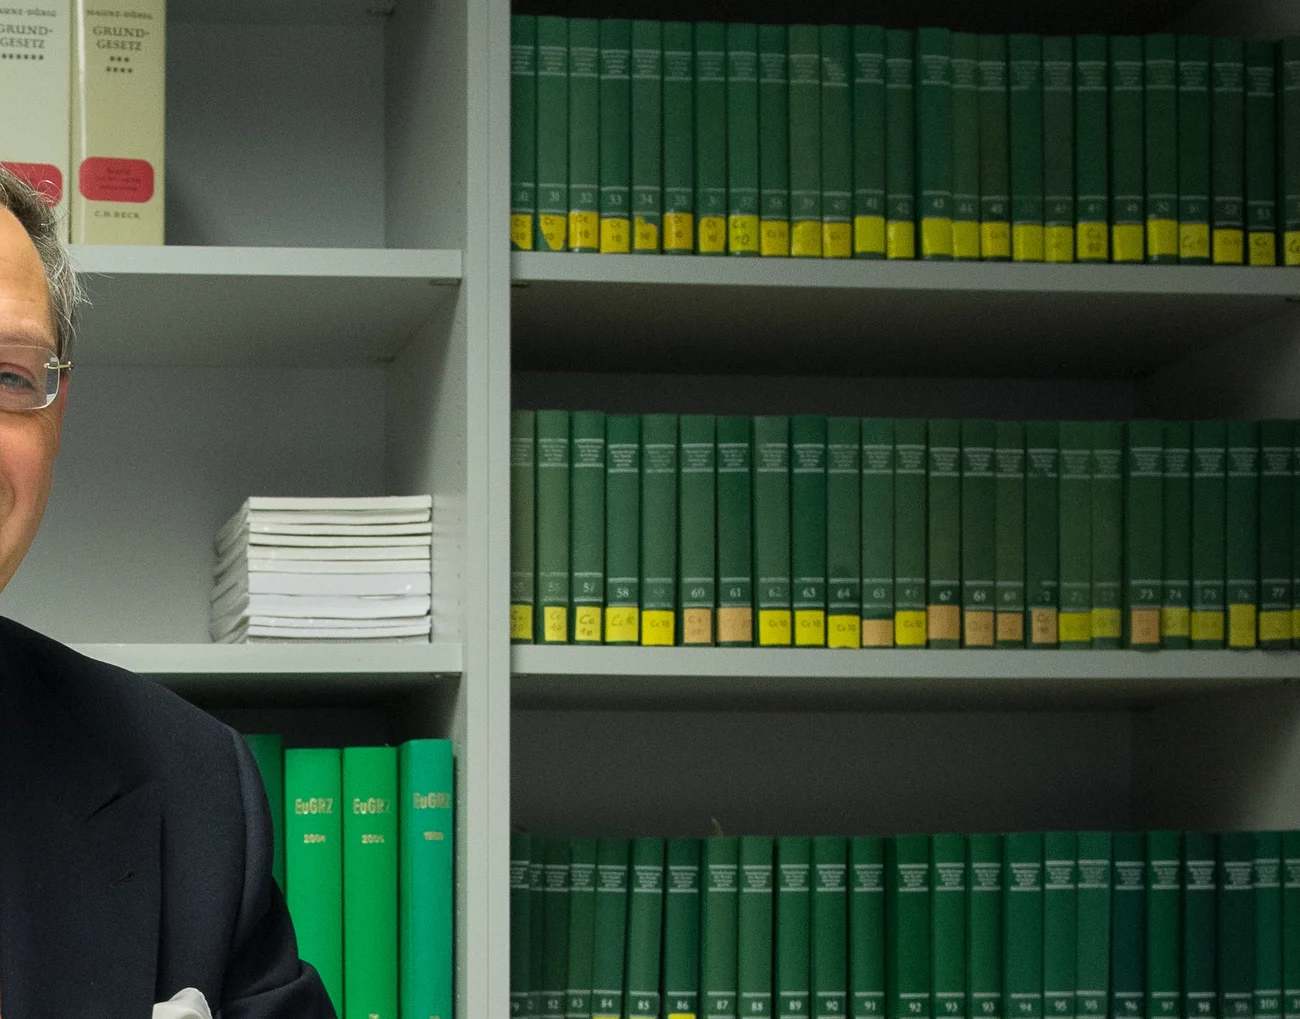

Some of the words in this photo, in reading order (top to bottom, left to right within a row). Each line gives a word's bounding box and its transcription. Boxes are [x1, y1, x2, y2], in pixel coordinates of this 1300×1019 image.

[92, 25, 150, 38] GRUND-
[0, 37, 45, 49] GESETZ
[96, 39, 142, 51] GESETZ
[616, 588, 629, 598] 58
[691, 587, 705, 598] 60
[730, 588, 741, 598] 61
[803, 587, 815, 598] 63
[837, 588, 850, 598] 64
[295, 798, 333, 814] EuGRZ
[600, 998, 612, 1009] 84
[637, 1000, 649, 1011] 85
[676, 1000, 688, 1011] 86
[716, 1000, 728, 1011] 87
[751, 1001, 763, 1012] 88
[789, 1001, 801, 1011] 89
[826, 1001, 838, 1011] 90
[864, 1001, 876, 1011] 91
[908, 1002, 921, 1013] 92
[945, 1001, 958, 1013] 93
[982, 1001, 994, 1013] 93
[1019, 1002, 1032, 1013] 94
[1054, 1001, 1067, 1012] 95
[1085, 1000, 1097, 1011] 95
[1125, 1001, 1138, 1012] 96
[1161, 1001, 1174, 1011] 97
